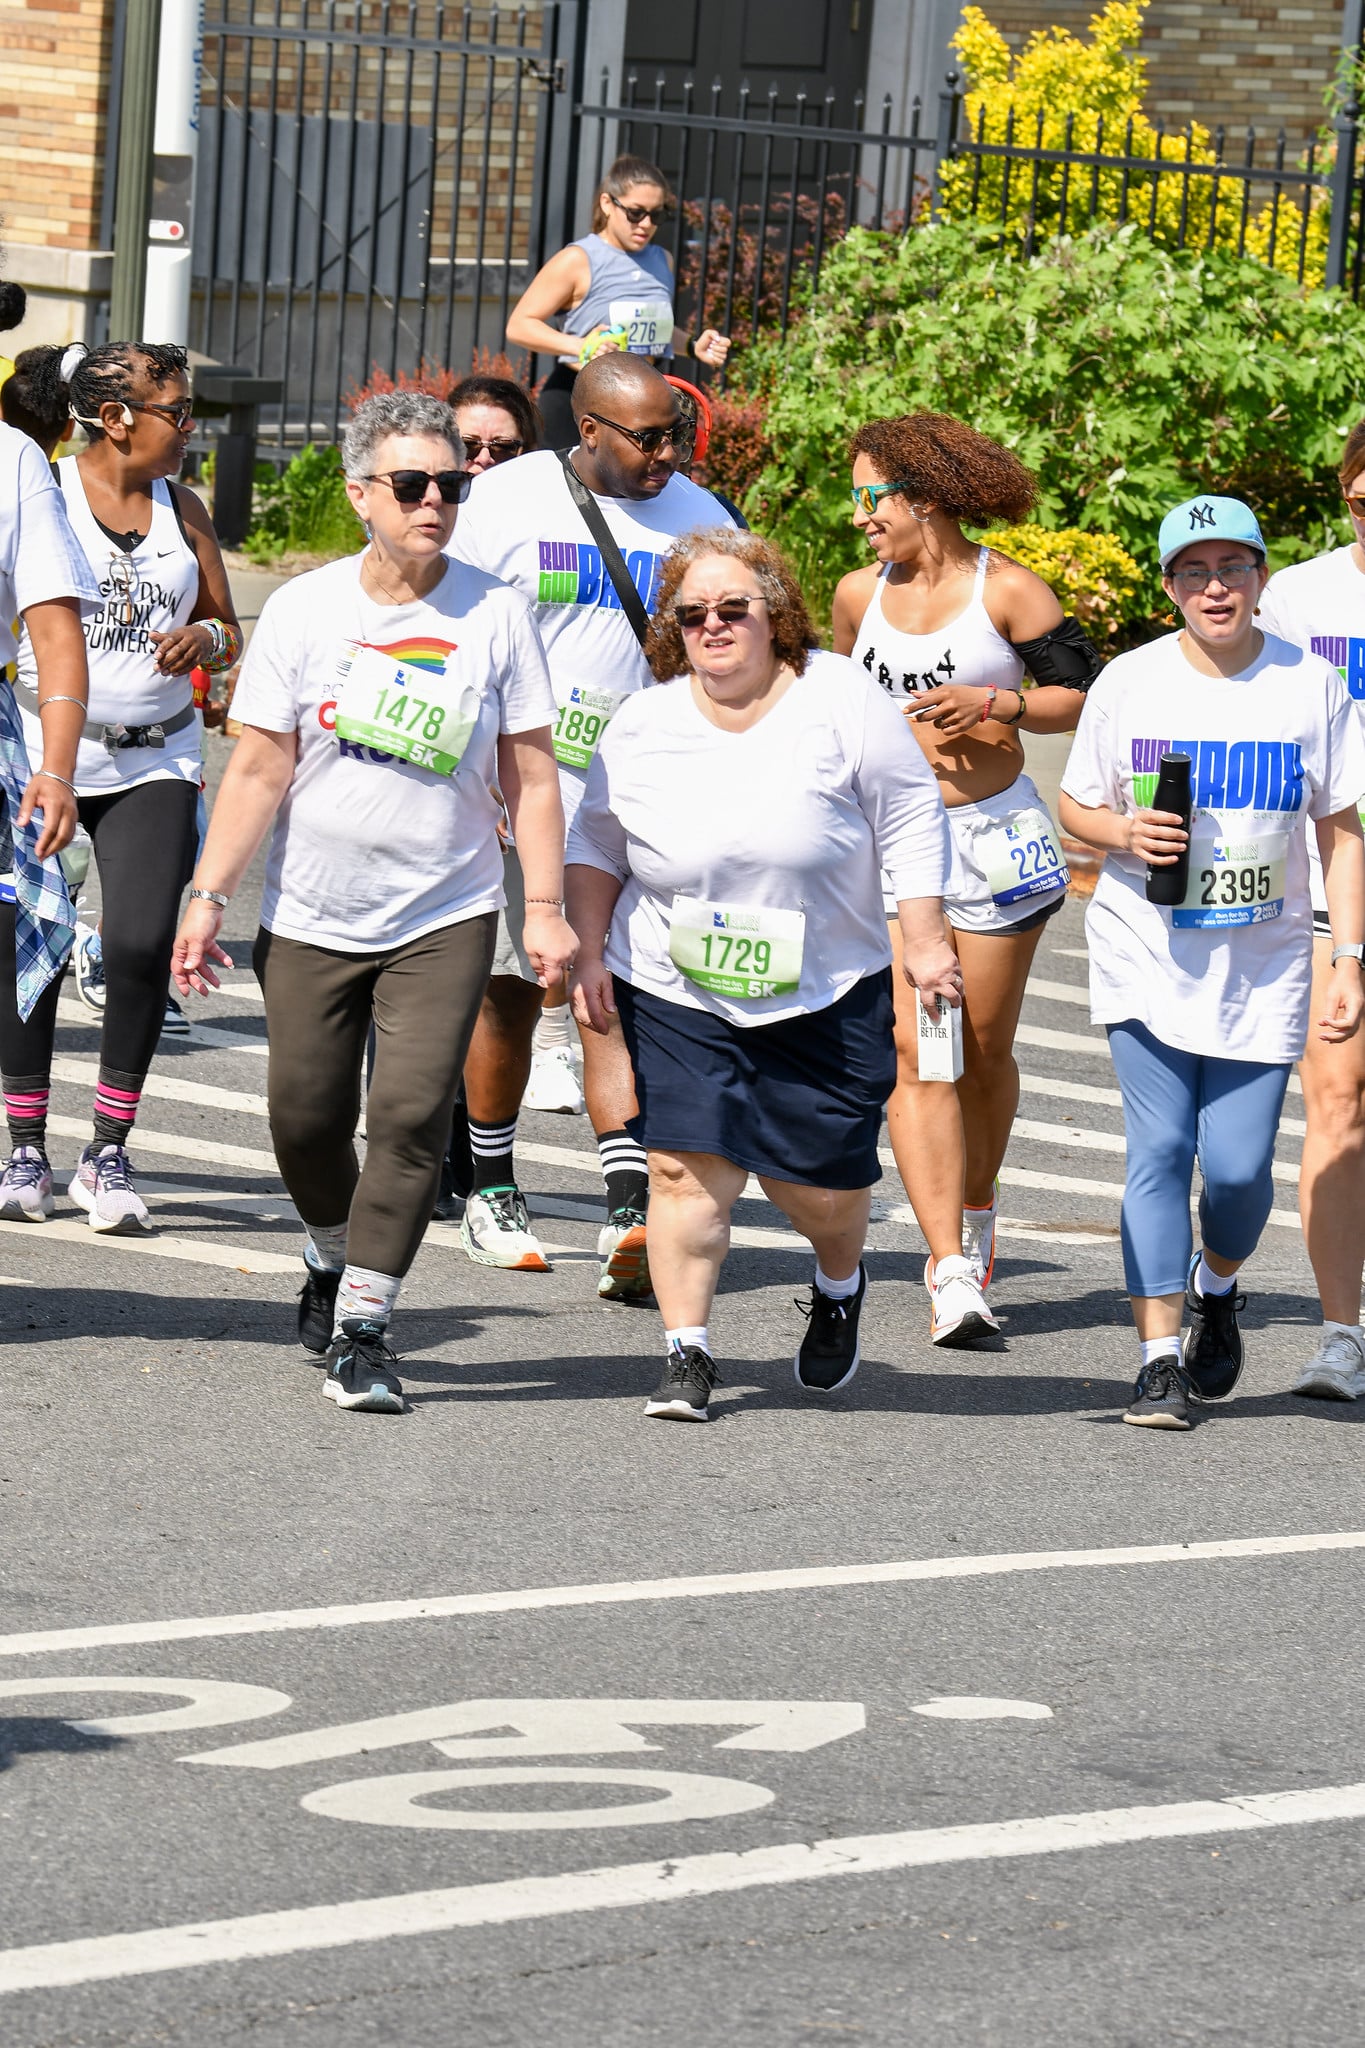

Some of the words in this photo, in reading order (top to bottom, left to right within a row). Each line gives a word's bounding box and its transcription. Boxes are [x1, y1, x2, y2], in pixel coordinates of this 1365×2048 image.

[628, 321, 657, 343] 276
[538, 541, 578, 571] RUN
[137, 581, 189, 618] DOWN
[372, 688, 446, 741] 1478
[408, 742, 440, 769] 5K
[1010, 834, 1059, 881] 225
[1200, 865, 1271, 905] 2395
[1252, 905, 1264, 923] 2
[701, 933, 772, 975] 1729
[747, 979, 778, 999] 5K
